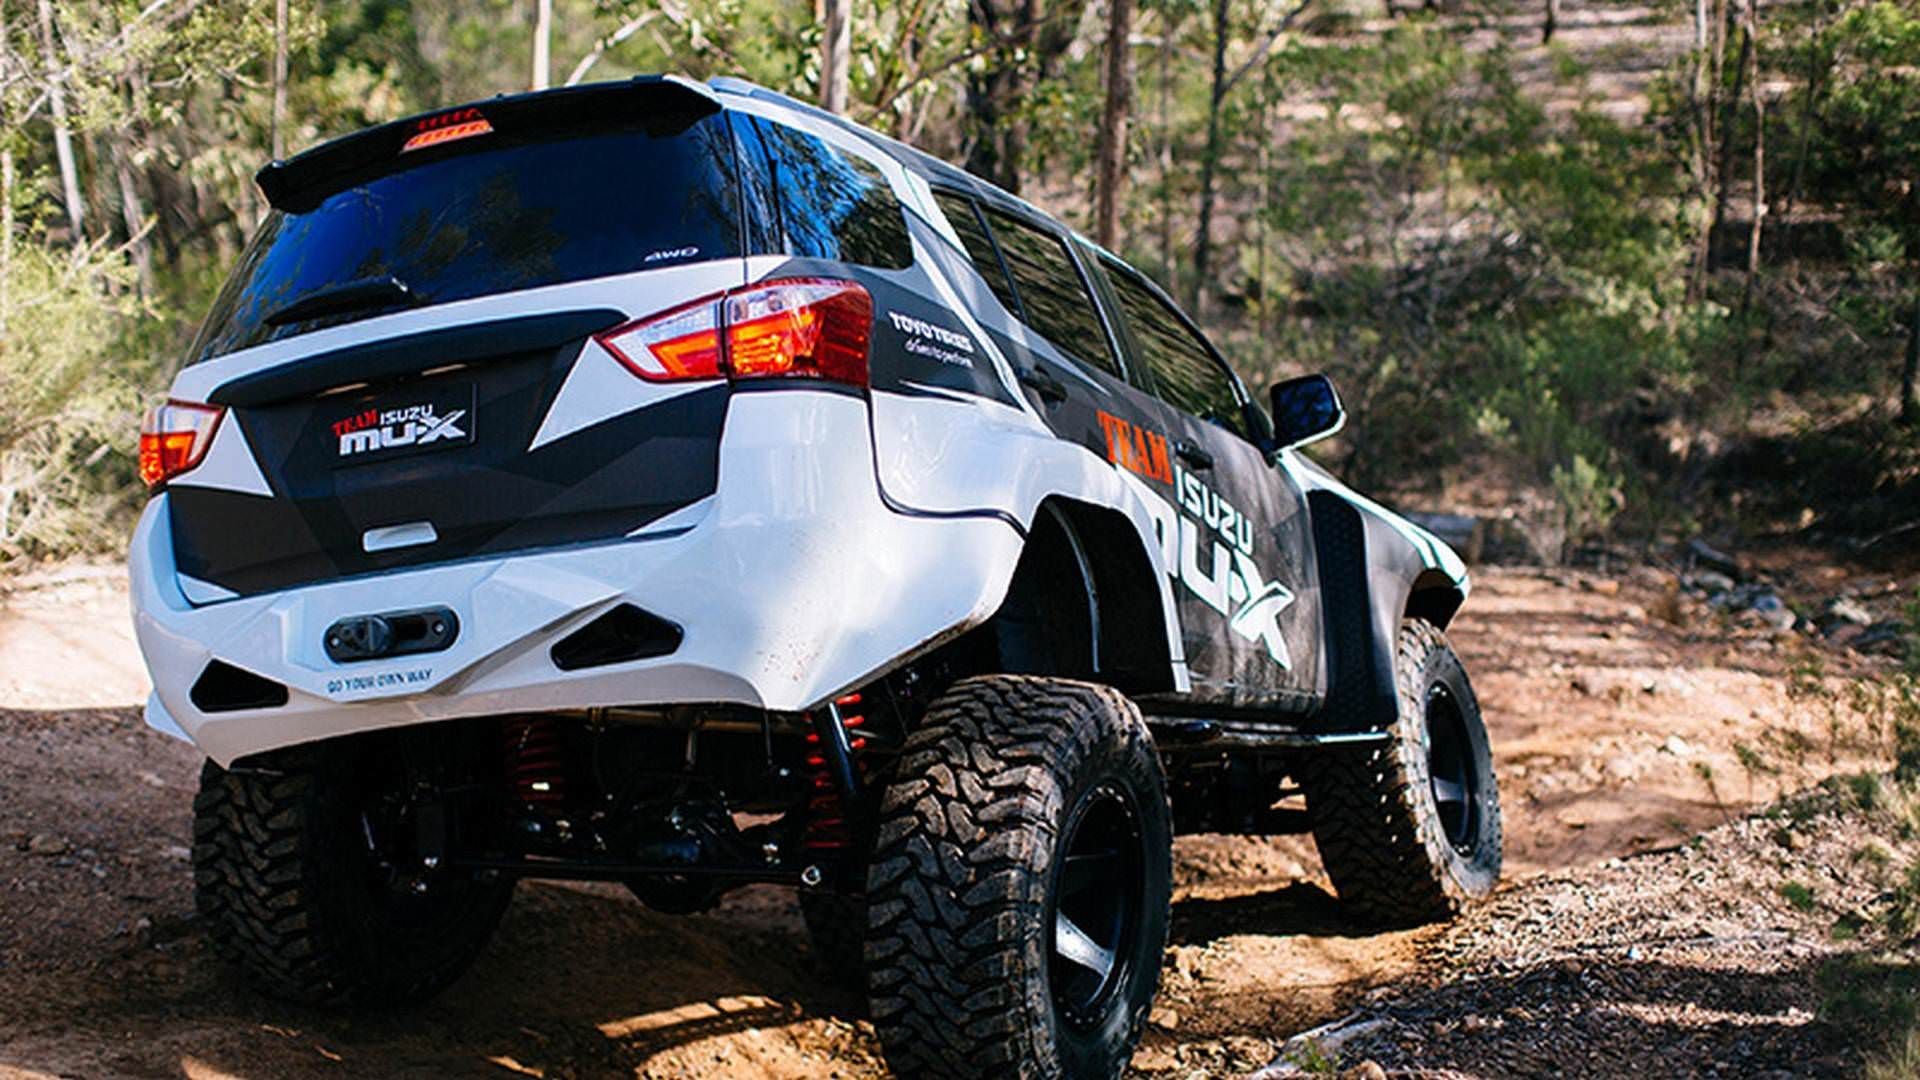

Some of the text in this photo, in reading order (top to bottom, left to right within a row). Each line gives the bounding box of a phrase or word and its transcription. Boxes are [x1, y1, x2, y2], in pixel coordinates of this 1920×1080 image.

[330, 404, 433, 436] TEAM ISUZU
[1096, 409, 1253, 556] TEAM ISUZU
